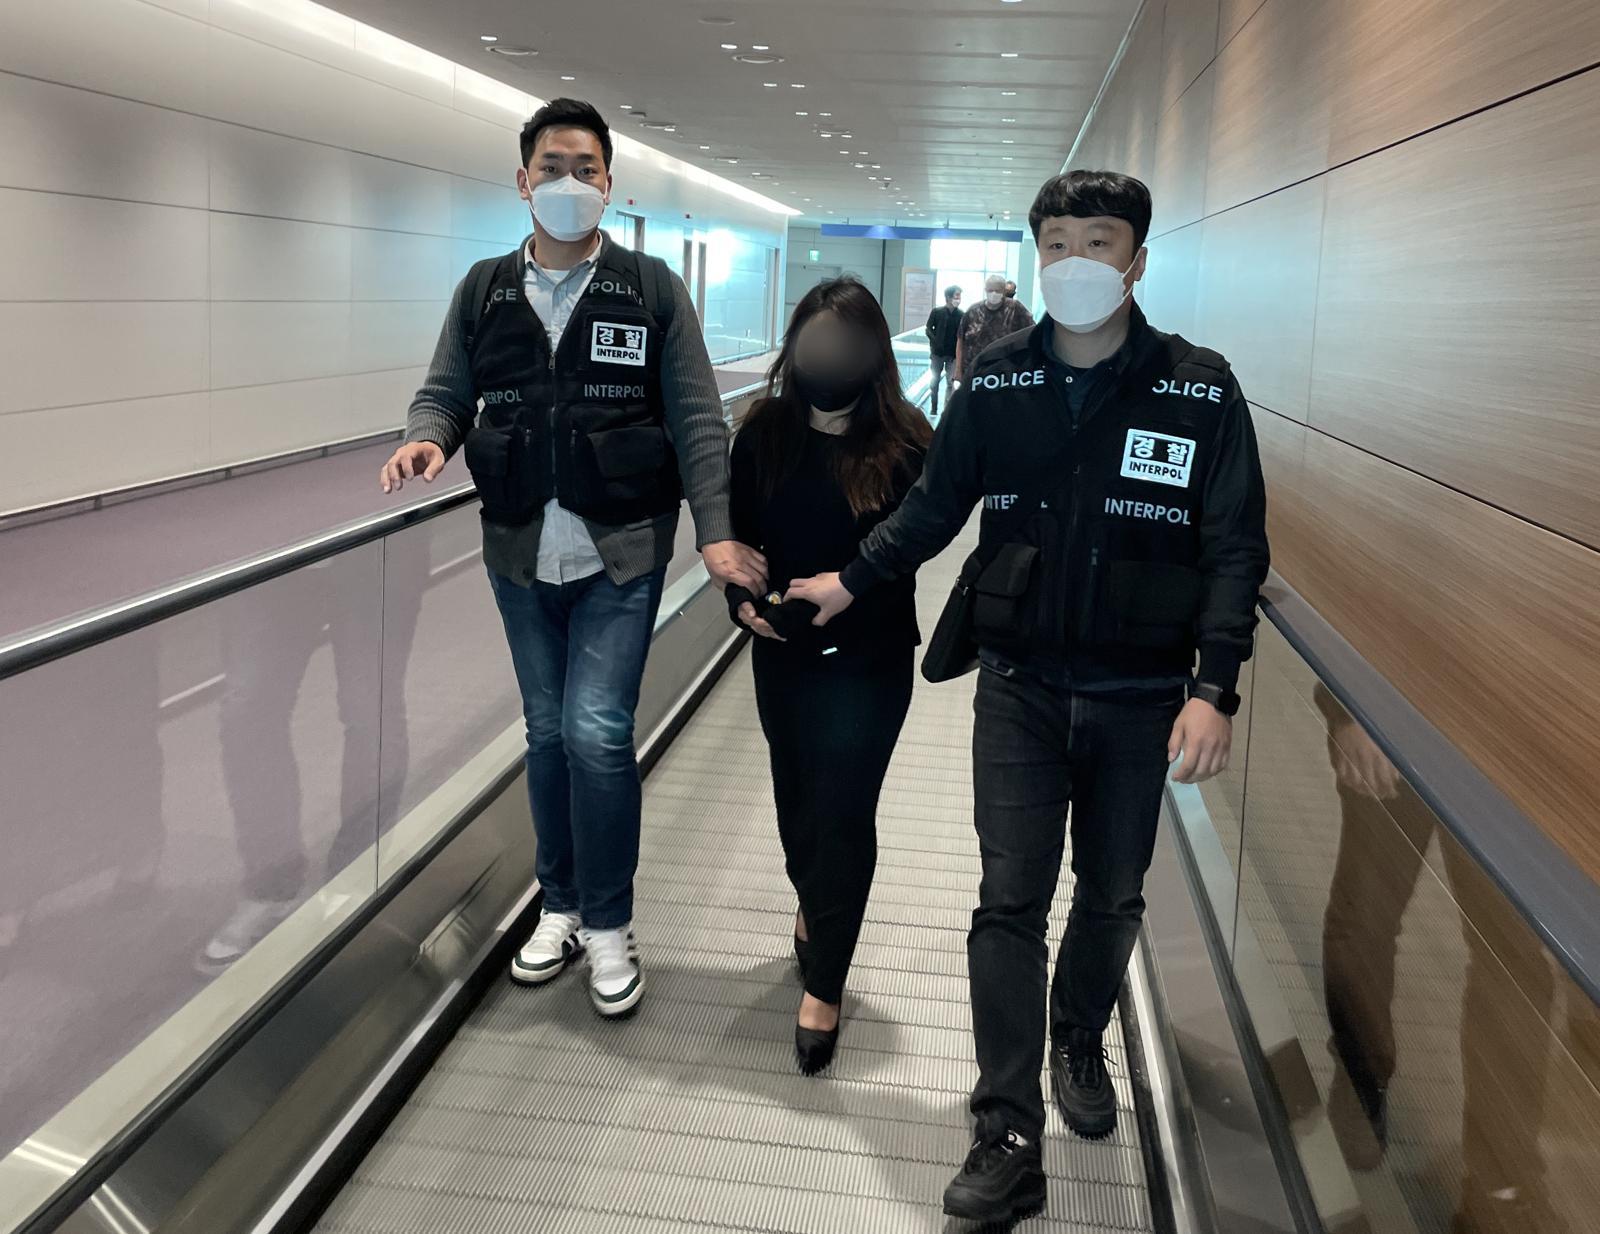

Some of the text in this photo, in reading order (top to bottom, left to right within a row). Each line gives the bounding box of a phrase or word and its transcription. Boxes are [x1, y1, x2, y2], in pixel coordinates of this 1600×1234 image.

[597, 348, 640, 360] INTERPOL
[971, 370, 1045, 391] POLICE
[584, 384, 645, 399] INTERPOL
[1152, 379, 1223, 403] OLICE
[1129, 461, 1183, 480] INTERPOL
[1104, 497, 1191, 526] INTERPOL
